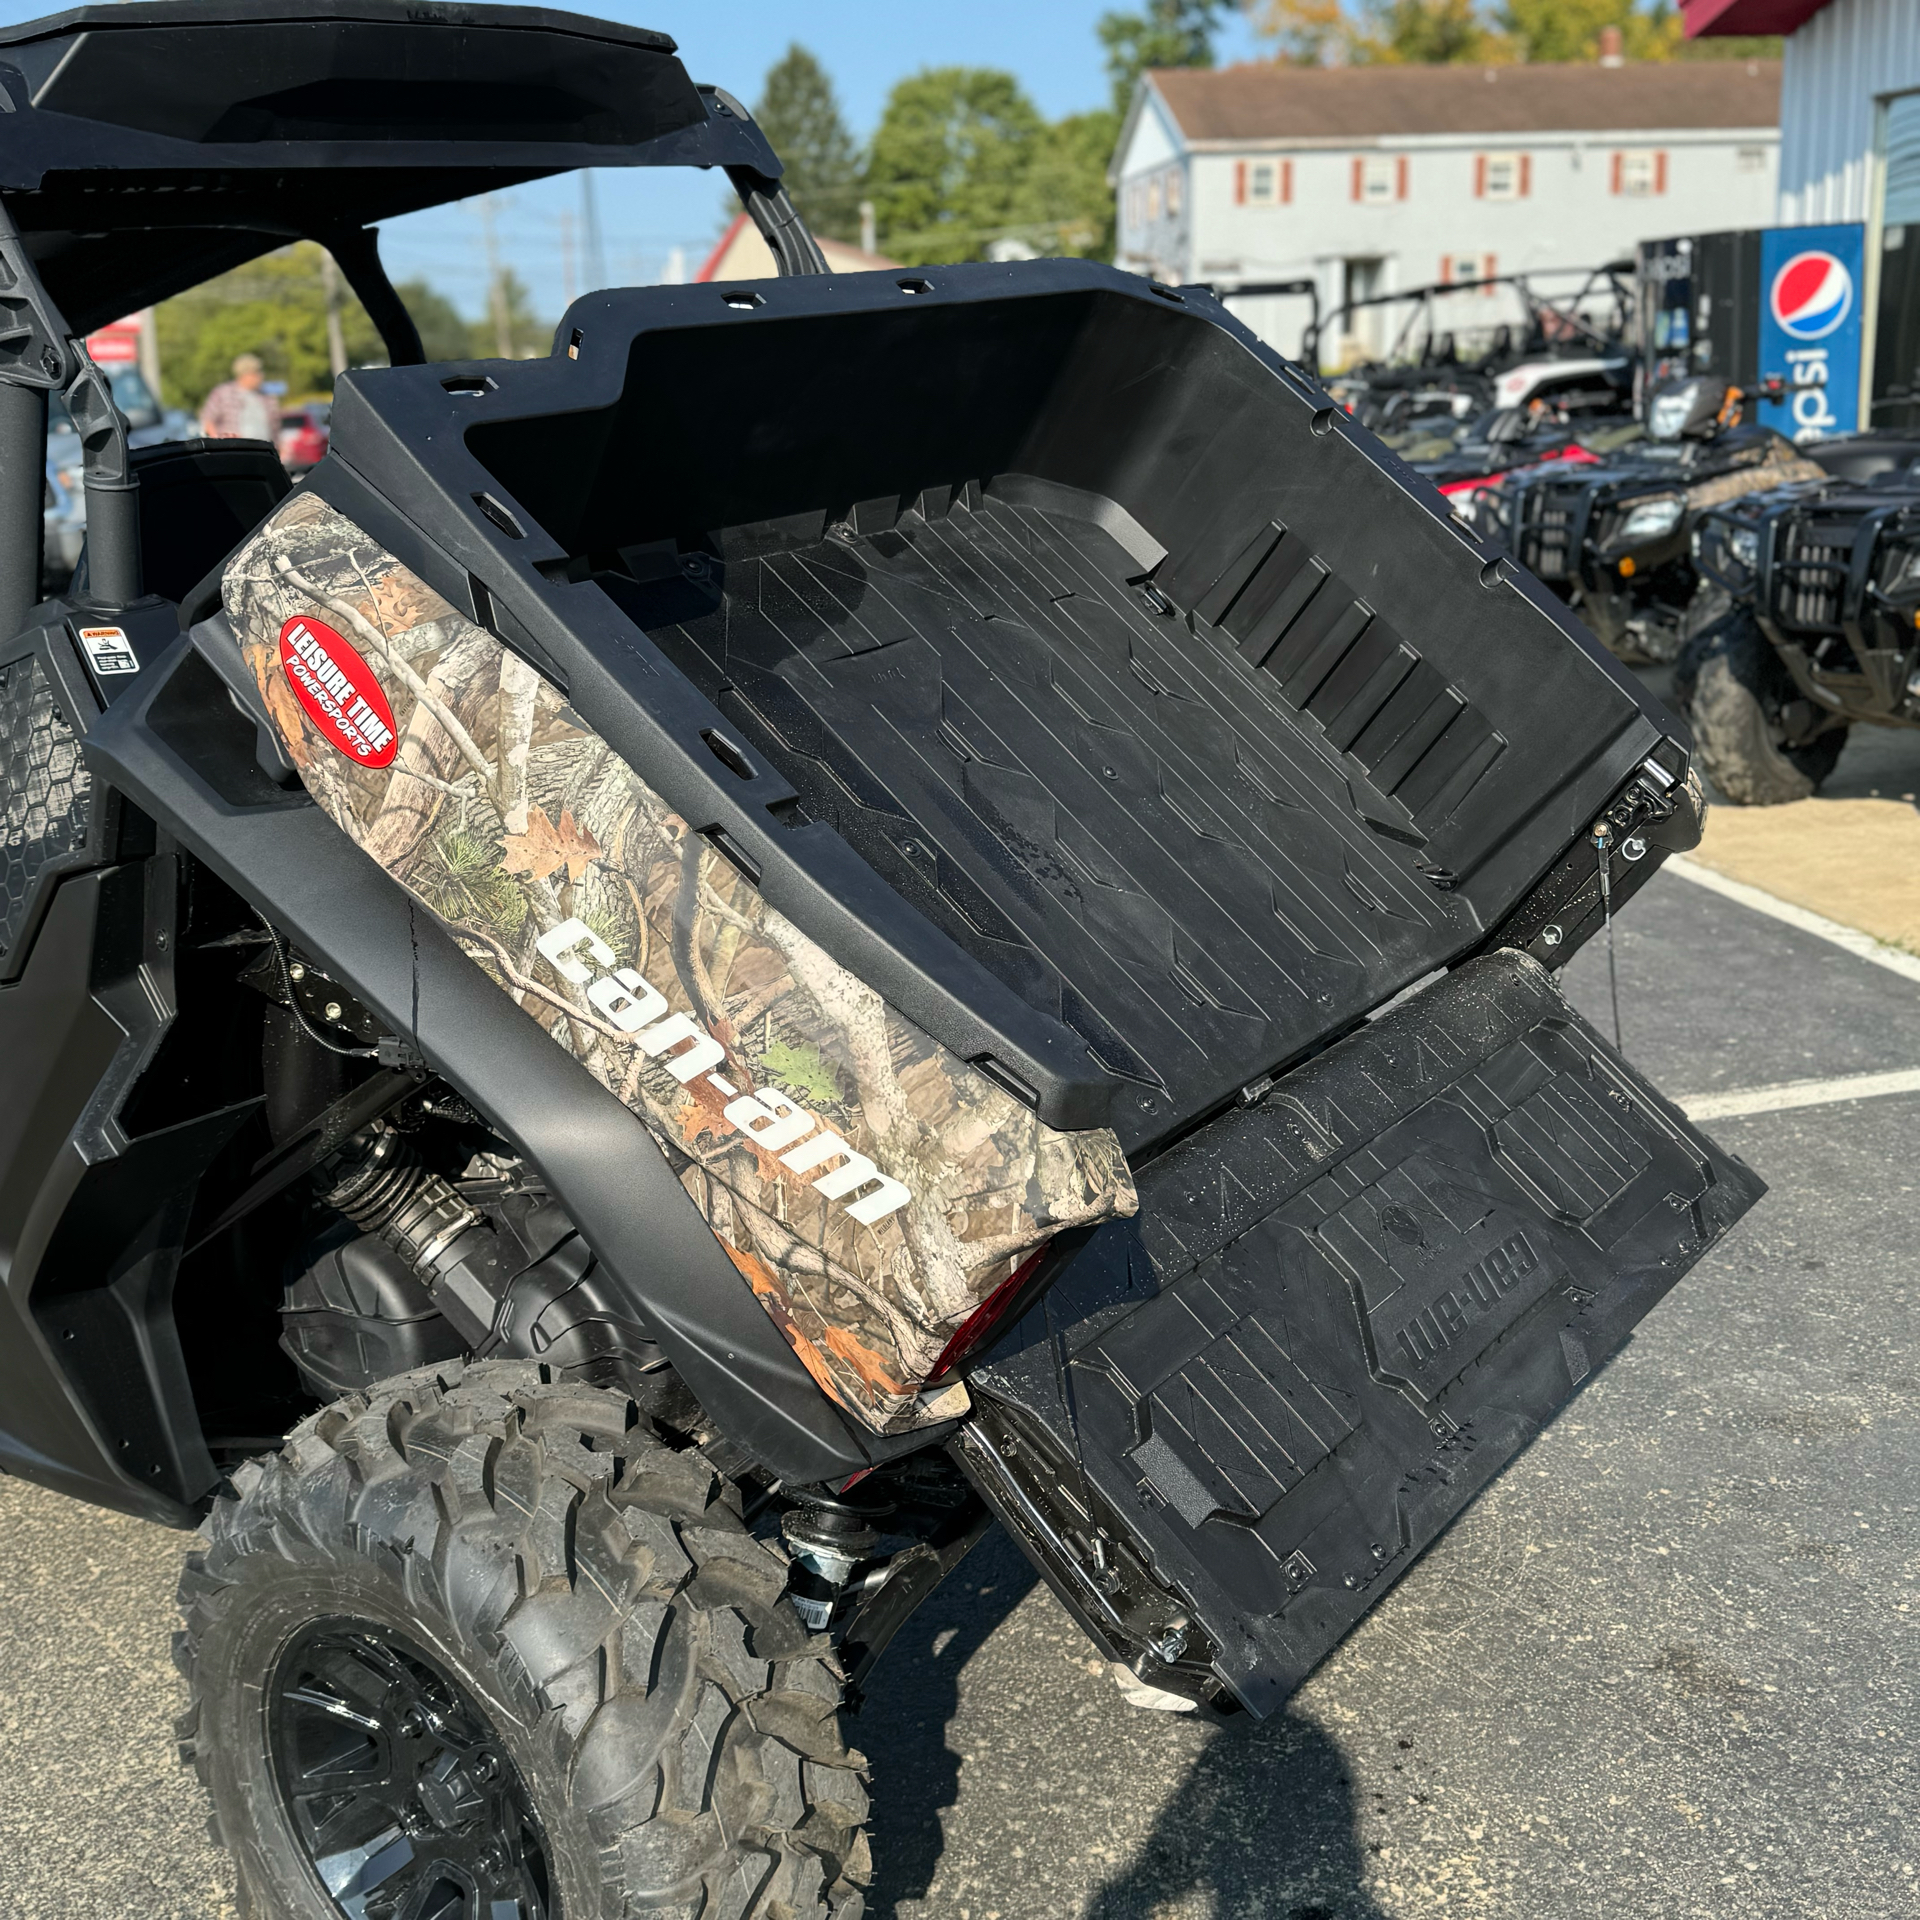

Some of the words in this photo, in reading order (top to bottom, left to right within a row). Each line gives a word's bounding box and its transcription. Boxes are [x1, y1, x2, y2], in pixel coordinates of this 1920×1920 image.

[286, 622, 356, 707] LEISURE
[346, 694, 395, 754] TIME
[286, 655, 372, 756] POWERSPORTS
